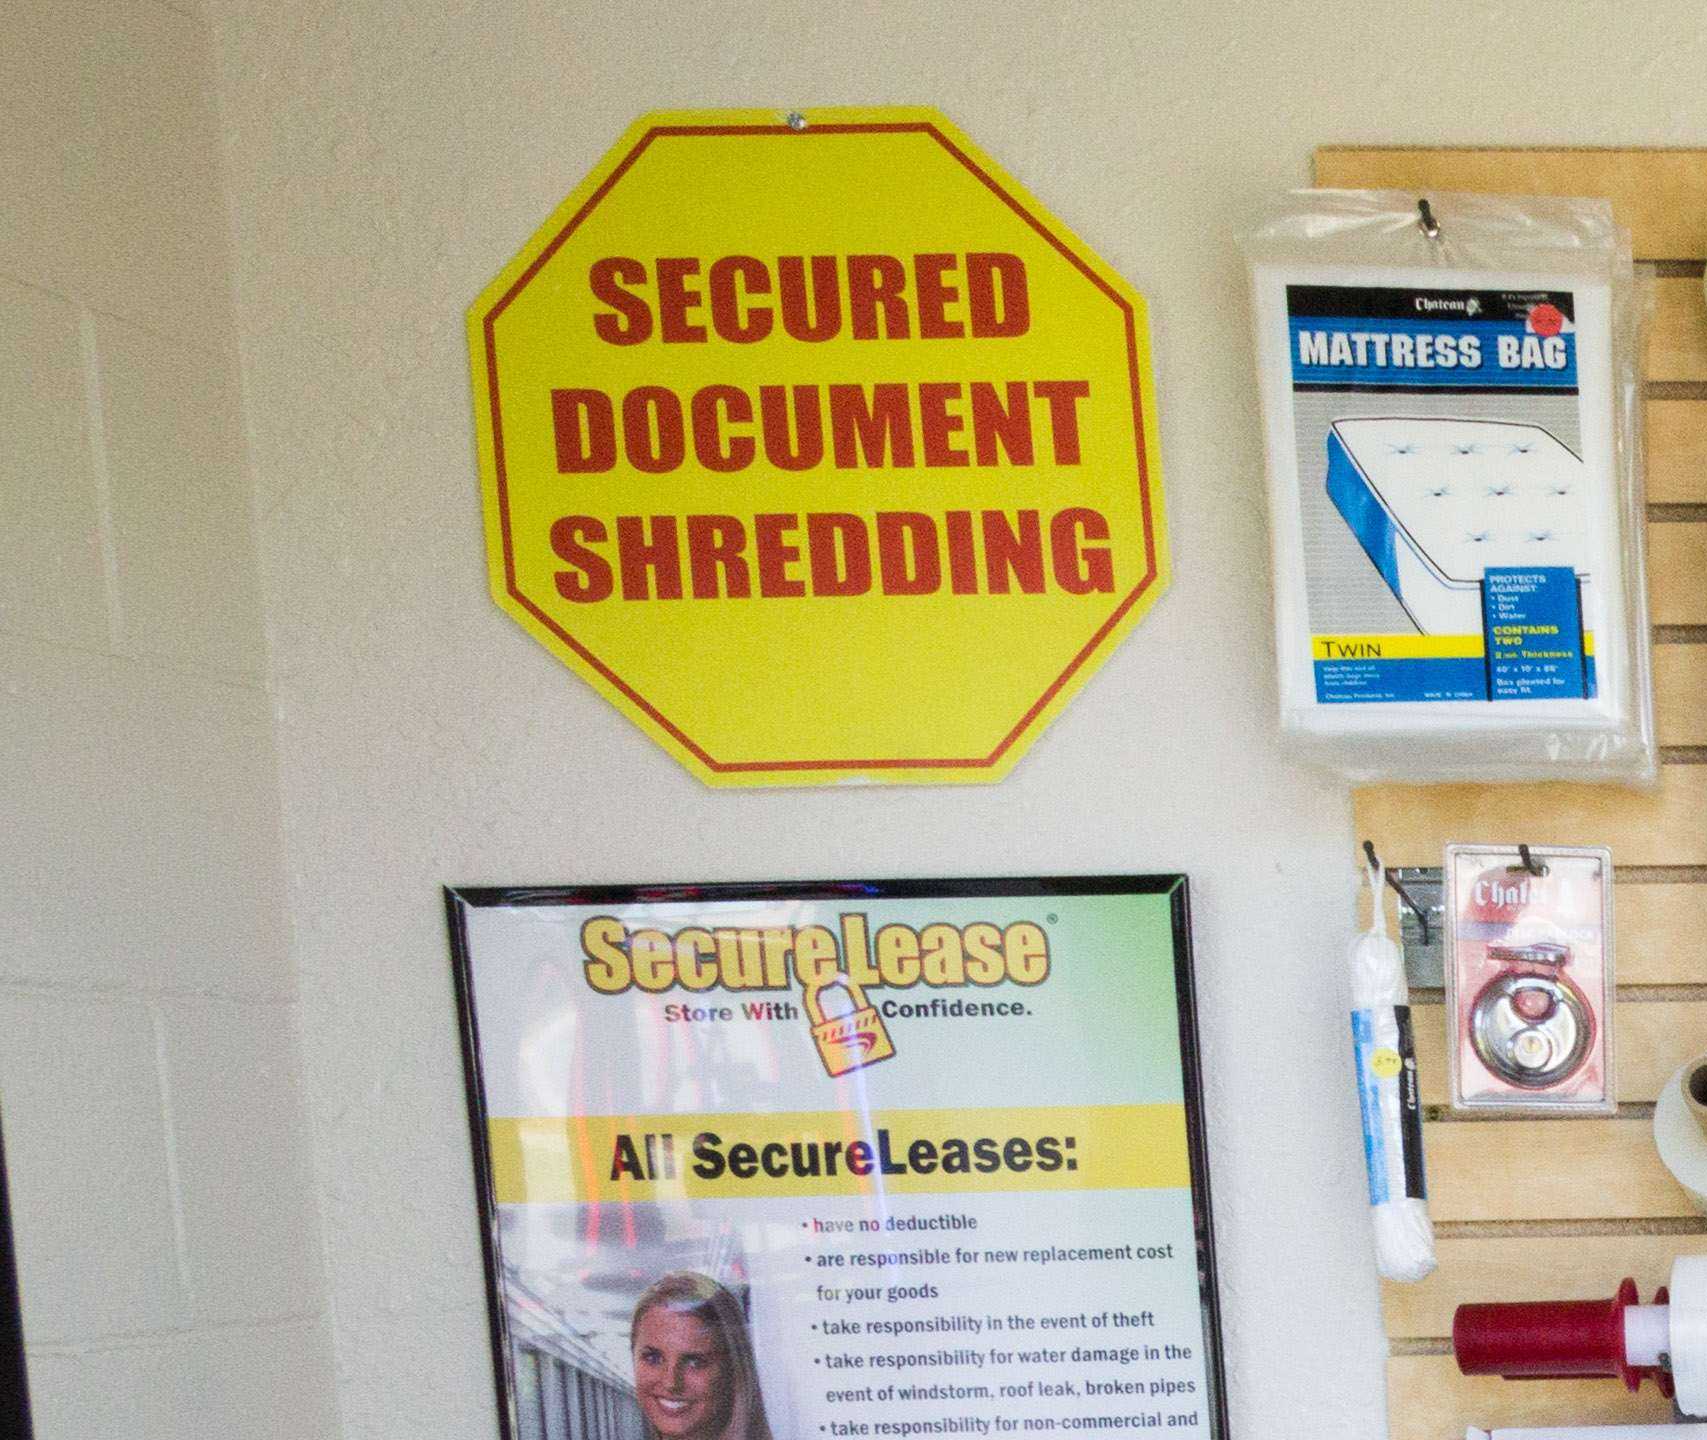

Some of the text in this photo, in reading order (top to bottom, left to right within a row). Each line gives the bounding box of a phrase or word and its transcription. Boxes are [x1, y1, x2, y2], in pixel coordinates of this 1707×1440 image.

[589, 253, 1030, 345] SECURED
[1416, 298, 1465, 311] Chateau
[1300, 330, 1566, 369] MATTRESS BAG
[551, 381, 1090, 473] DOCUMENT
[548, 508, 1116, 603] SHREDDING
[1489, 575, 1546, 583] PROTECTS
[1490, 584, 1537, 592] AGAINST
[1322, 641, 1382, 658] TWIN
[580, 912, 1049, 995] SecureLease
[665, 998, 1033, 1022] Store With Confidence.
[610, 1131, 1078, 1180] All SecureLeases:
[813, 1215, 977, 1233] have no deductible
[817, 1244, 1173, 1269] are responsible for new replacement cost
